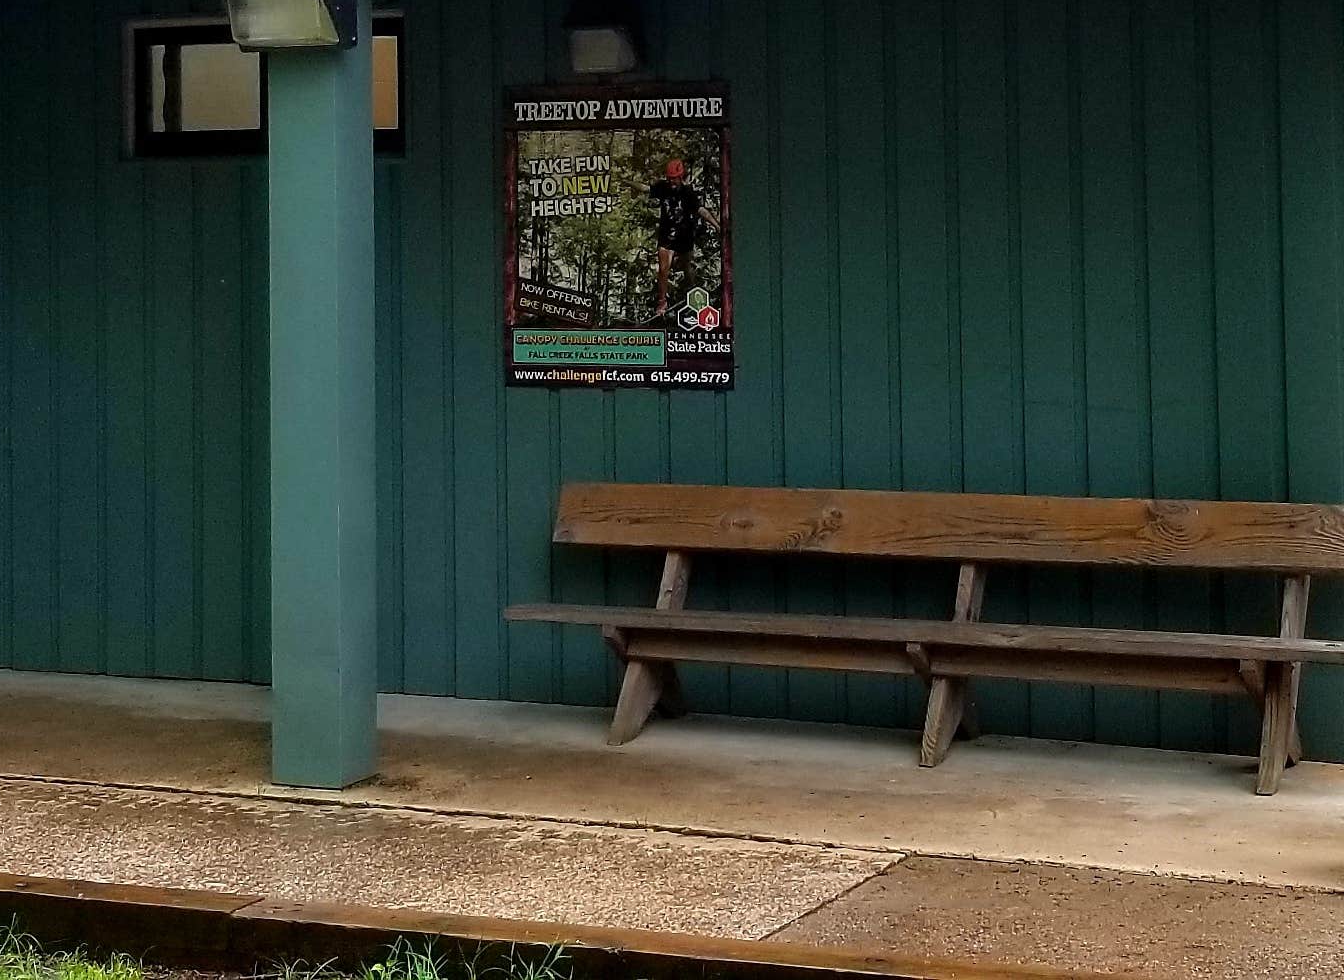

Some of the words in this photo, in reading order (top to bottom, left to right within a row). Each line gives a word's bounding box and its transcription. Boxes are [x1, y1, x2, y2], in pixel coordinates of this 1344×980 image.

[514, 101, 601, 122] TREETOP
[605, 97, 723, 120] ADVENTURE
[529, 158, 572, 175] TAKE
[576, 155, 610, 172] FUN
[530, 178, 557, 197] TO
[563, 175, 611, 196] NEW
[531, 196, 612, 217] HEIGHTS!
[521, 282, 545, 296] NOW
[546, 289, 592, 308] OFFERING
[519, 297, 540, 310] BIKE
[542, 303, 589, 323] RENTALS!
[515, 335, 557, 345] CANOPY
[560, 336, 620, 346] CHALLENGE
[667, 332, 732, 340] TENNESSEE
[528, 351, 547, 359] FALL
[574, 351, 599, 360] FALLS
[600, 352, 625, 360] STATE
[626, 353, 649, 361] PARK
[667, 340, 697, 353] State
[697, 340, 731, 353] Parks
[650, 371, 730, 383] 615.499.5779
